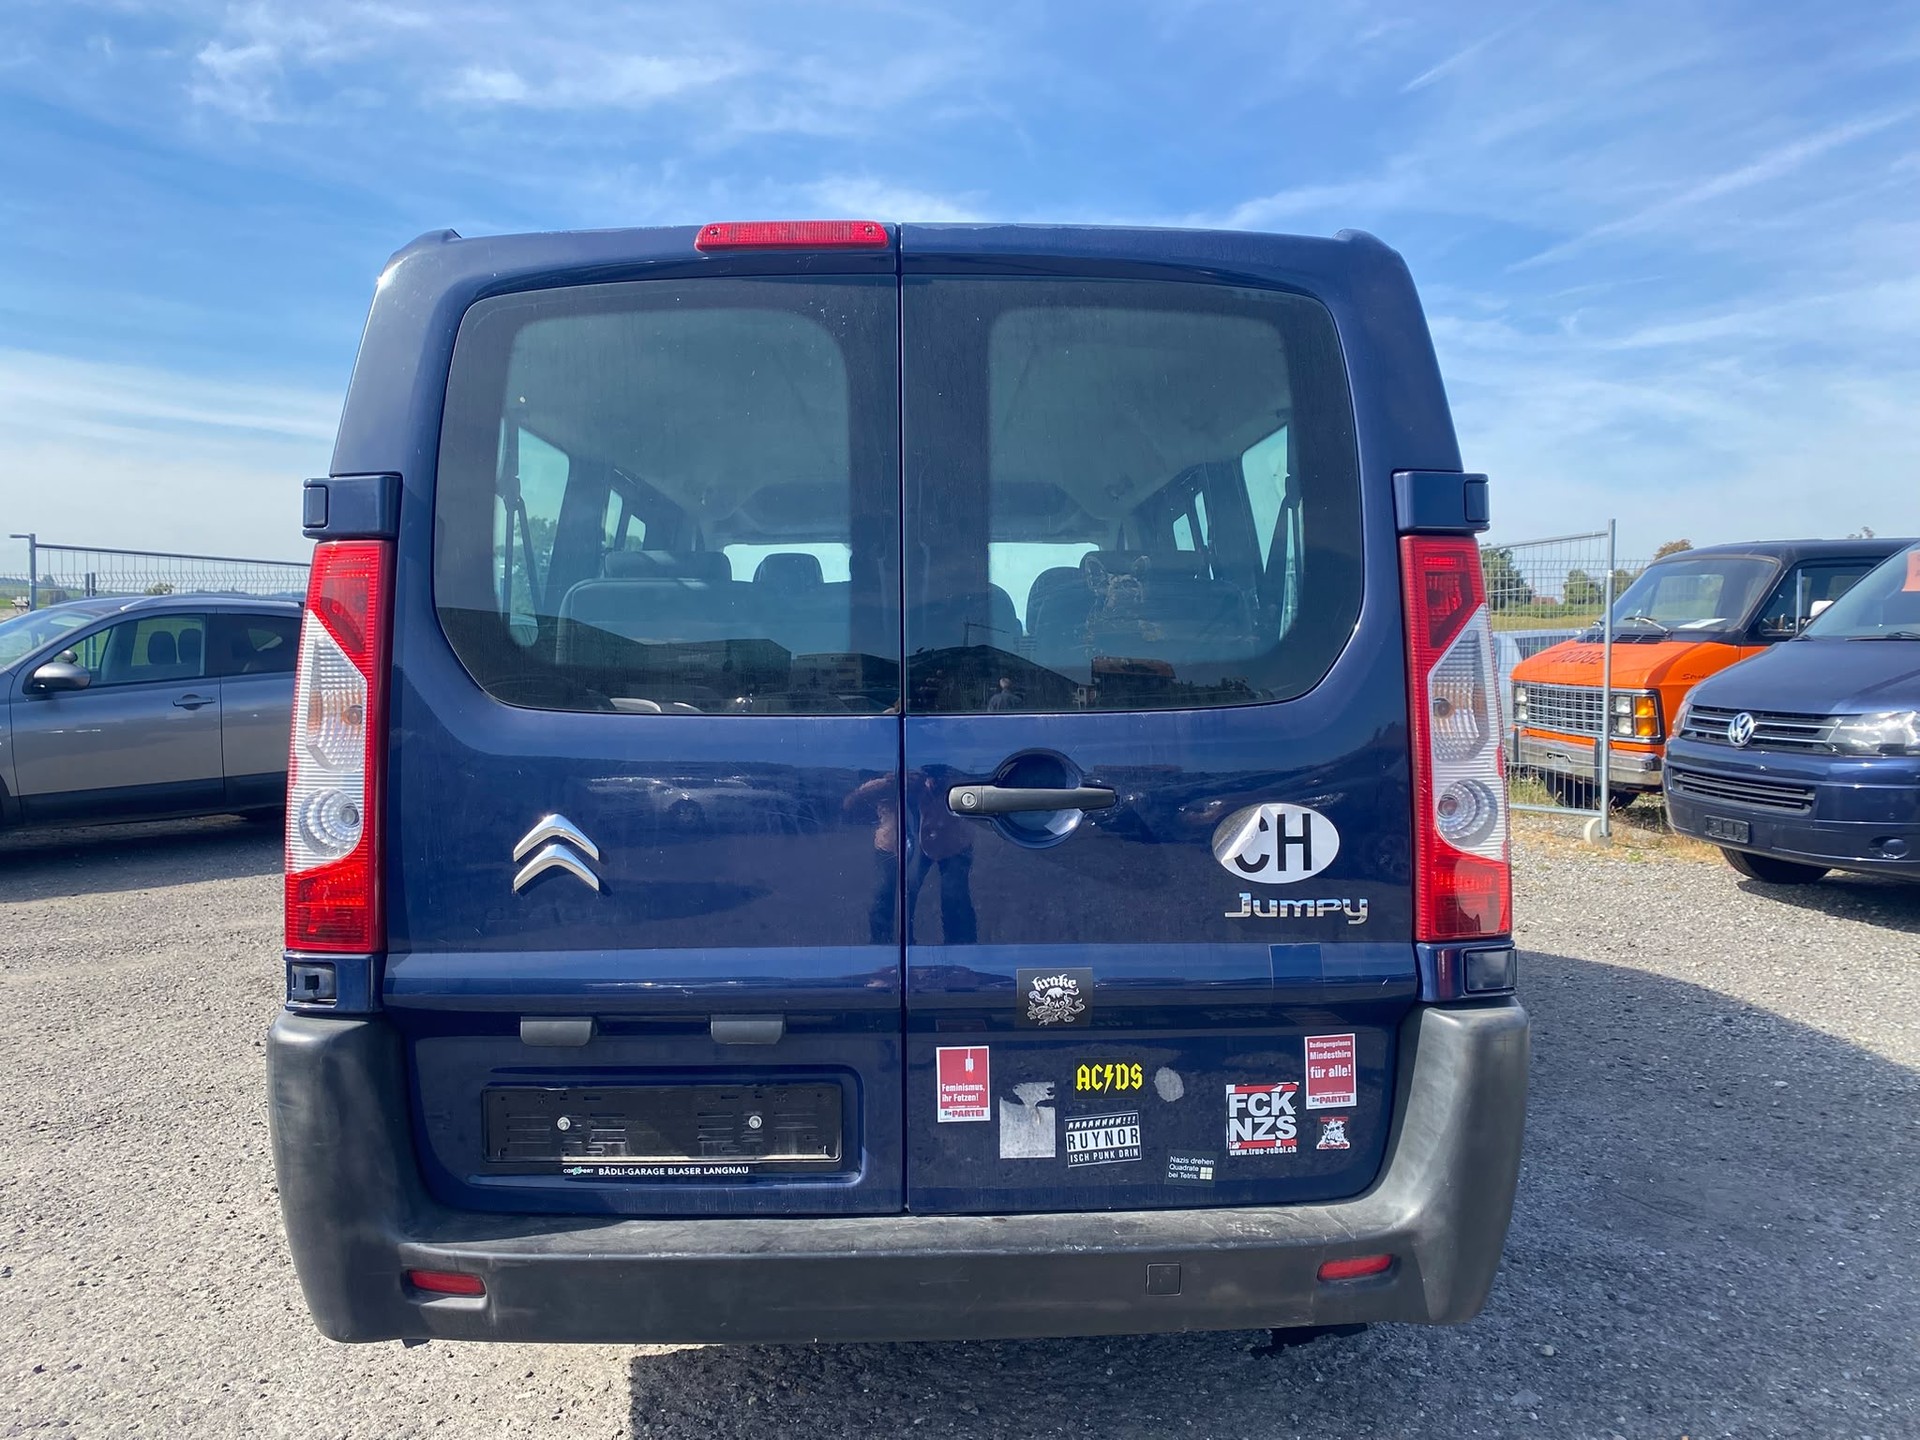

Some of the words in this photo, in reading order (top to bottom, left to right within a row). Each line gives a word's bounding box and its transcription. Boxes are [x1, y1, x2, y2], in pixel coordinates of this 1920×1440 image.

[1224, 892, 1369, 925] Jumpy
[1310, 1066, 1326, 1079] für
[1328, 1063, 1352, 1078] alle!
[941, 1083, 986, 1092] Feminismus,
[941, 1094, 952, 1102] ihr
[953, 1093, 979, 1102] Fotzen!
[1319, 1095, 1351, 1104] PARTEI
[1228, 1091, 1297, 1118] FCK
[952, 1109, 985, 1118] PARTEI
[1229, 1115, 1297, 1142] NZS
[1067, 1127, 1139, 1150] RUYNOR
[1070, 1152, 1090, 1163] ISCH
[1093, 1150, 1115, 1161] PUNK
[1118, 1147, 1139, 1158] DRIN
[1229, 1145, 1297, 1156] www.true-rebel.ch
[1170, 1156, 1190, 1164] Nazis
[1190, 1158, 1215, 1166] drehen
[598, 1166, 665, 1175] BÄDLI-GARAGE
[667, 1167, 701, 1175] BLASER
[703, 1166, 749, 1175] LANGNAU
[1169, 1163, 1200, 1172] Quadrate
